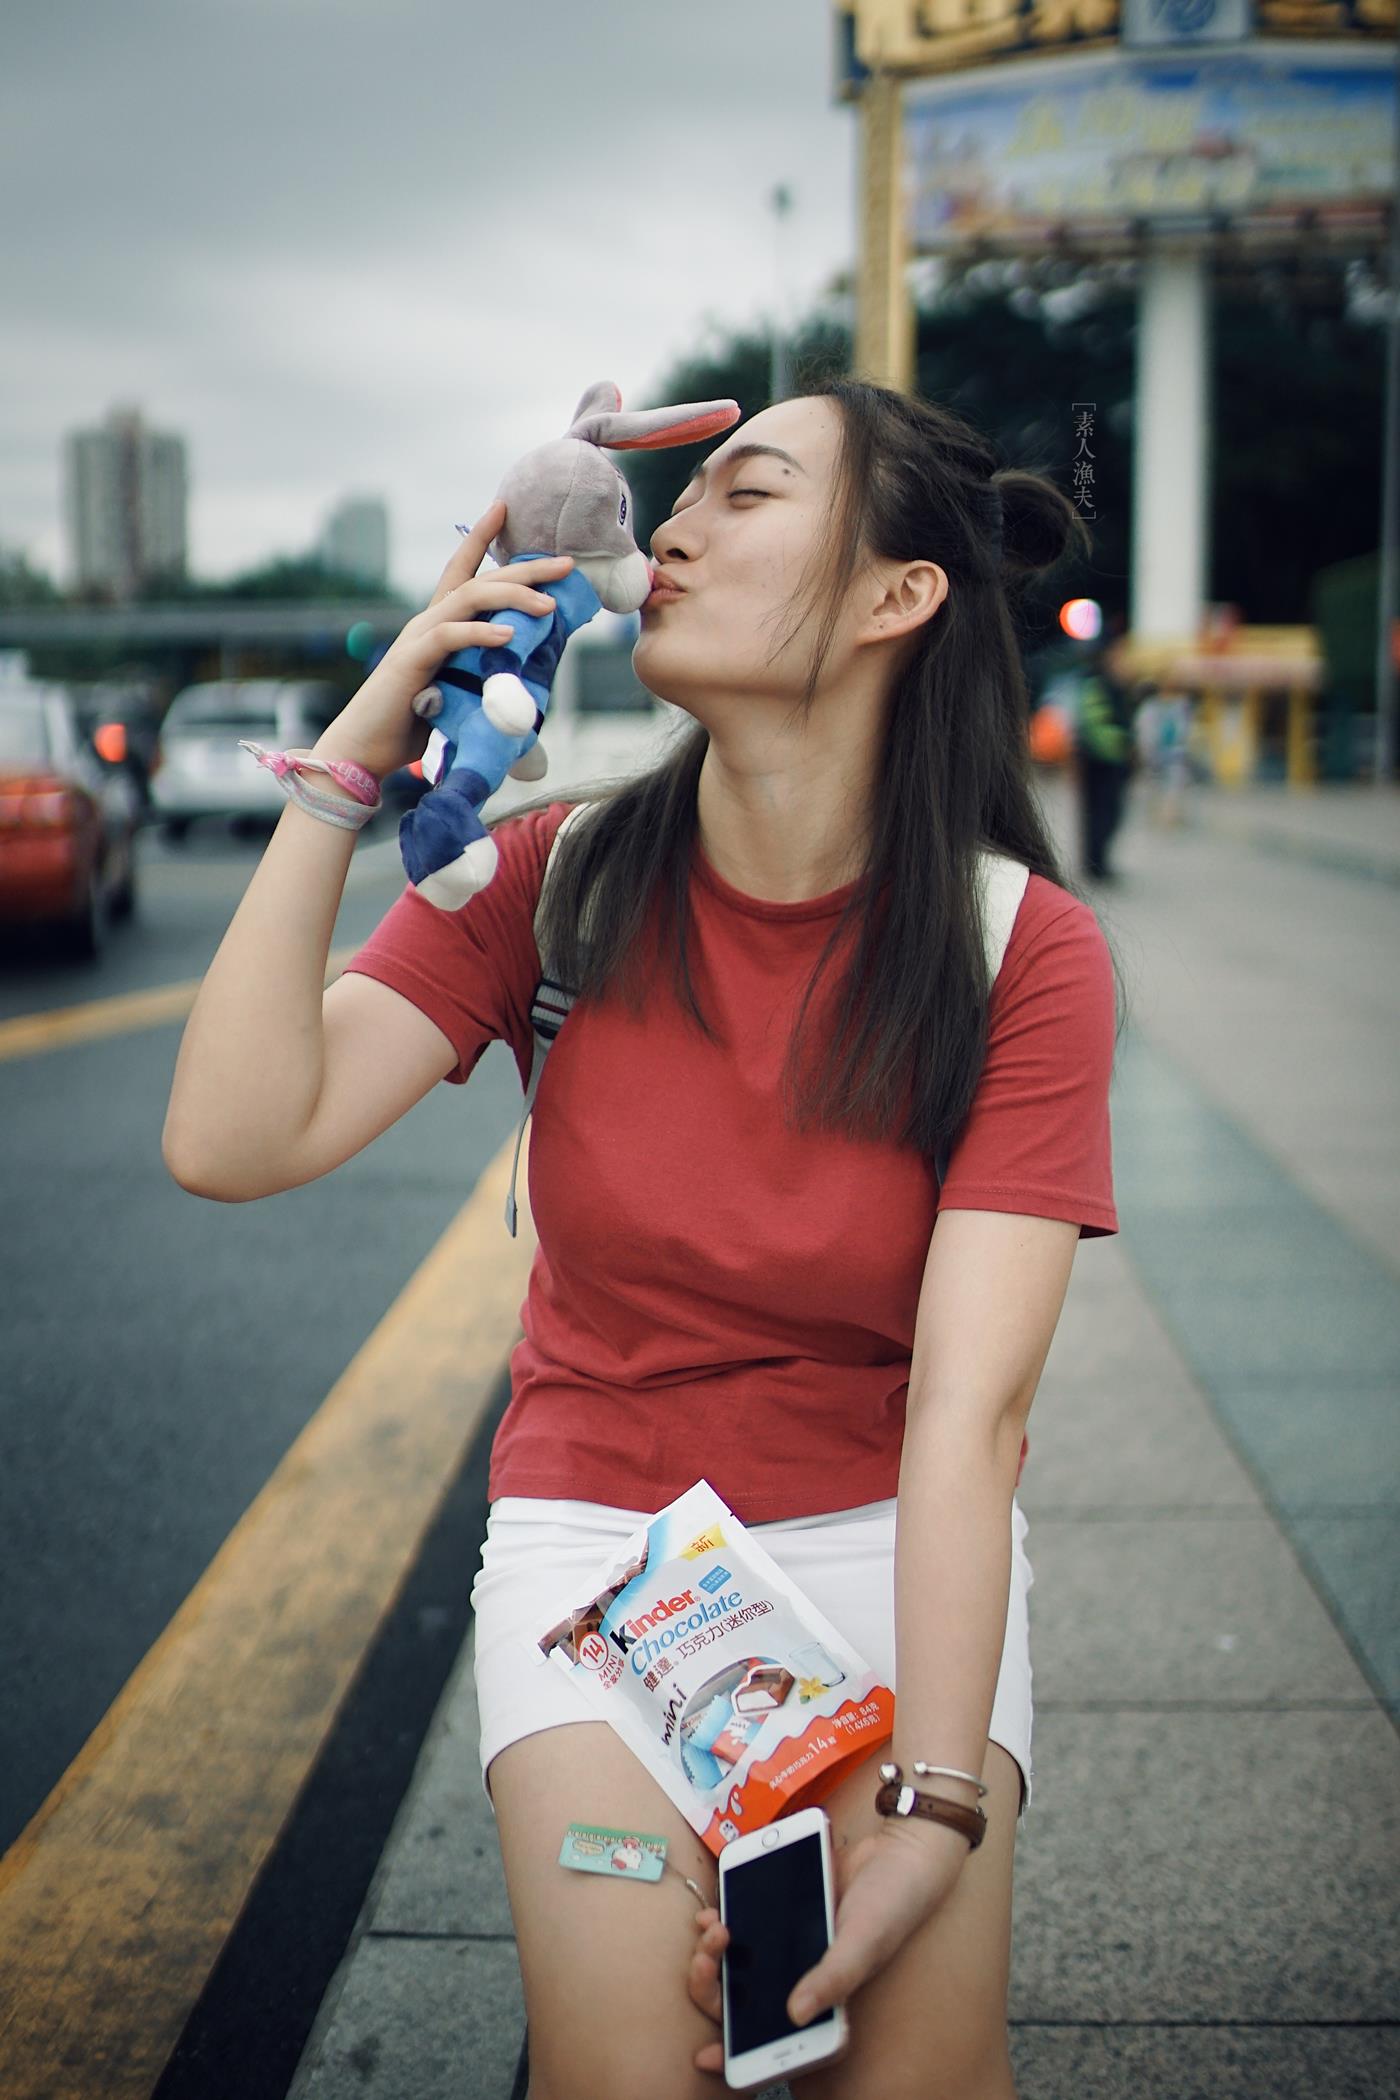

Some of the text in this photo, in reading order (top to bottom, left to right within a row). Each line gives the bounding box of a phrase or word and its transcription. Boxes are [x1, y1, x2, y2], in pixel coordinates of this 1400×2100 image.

[691, 1535, 714, 1552] 新
[630, 1592, 743, 1675] Chocolate
[583, 1638, 604, 1663] 14
[598, 1654, 620, 1680] MINI
[660, 1682, 689, 1746] mini
